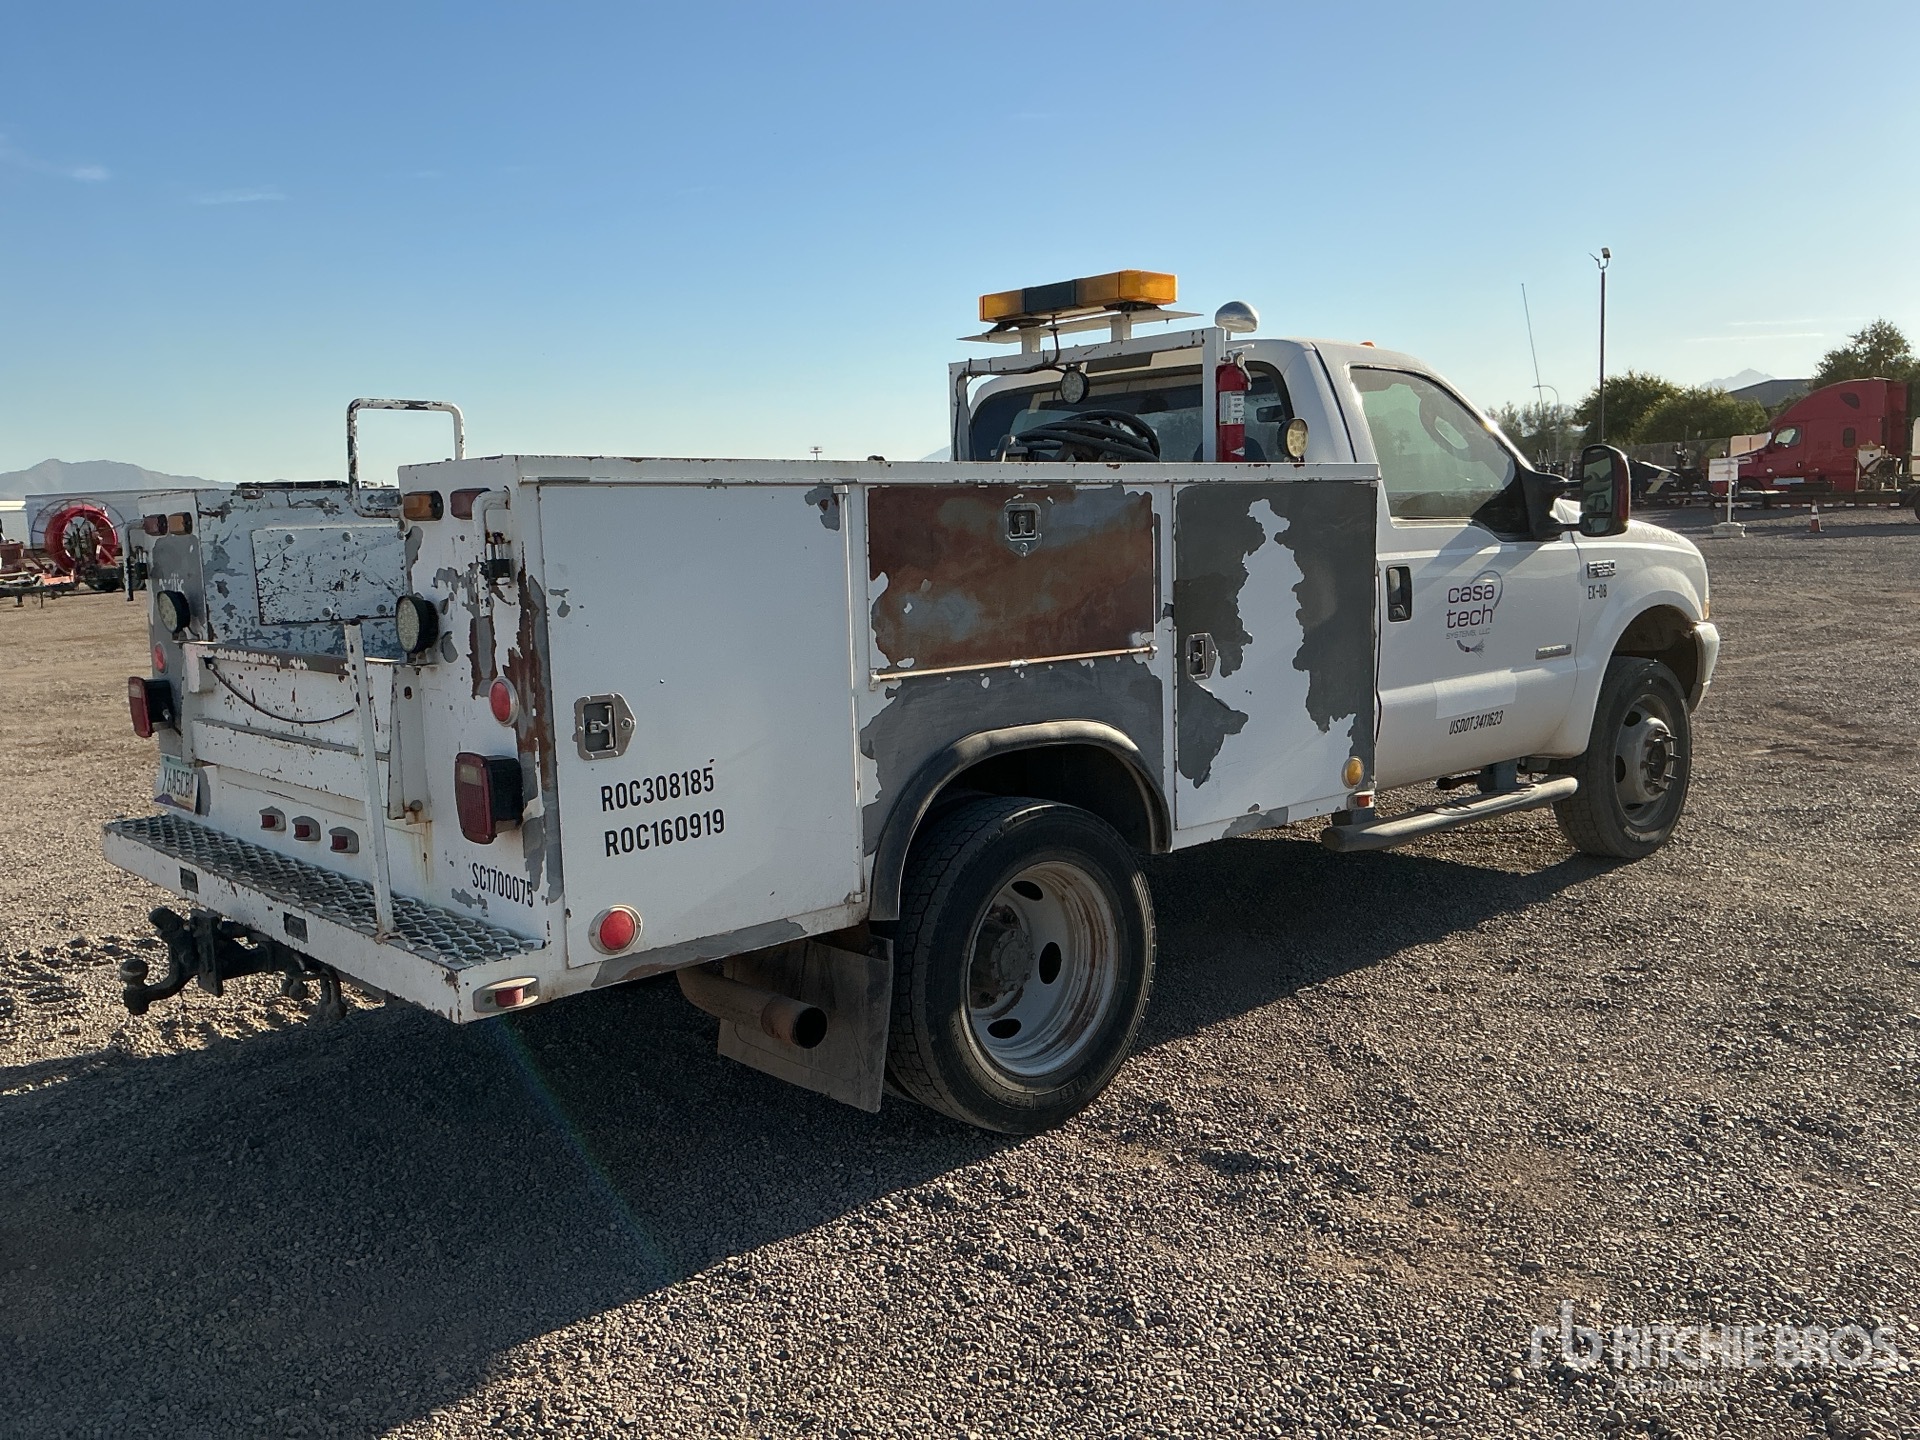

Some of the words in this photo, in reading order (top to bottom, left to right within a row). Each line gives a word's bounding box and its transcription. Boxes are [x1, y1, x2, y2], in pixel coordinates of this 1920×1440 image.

[1448, 583, 1495, 604] casa
[1588, 584, 1608, 600] EX-08
[1446, 604, 1494, 629] tech
[601, 766, 715, 812] ROC308185
[604, 808, 725, 858] ROC160919
[472, 862, 534, 908] SC1700075
